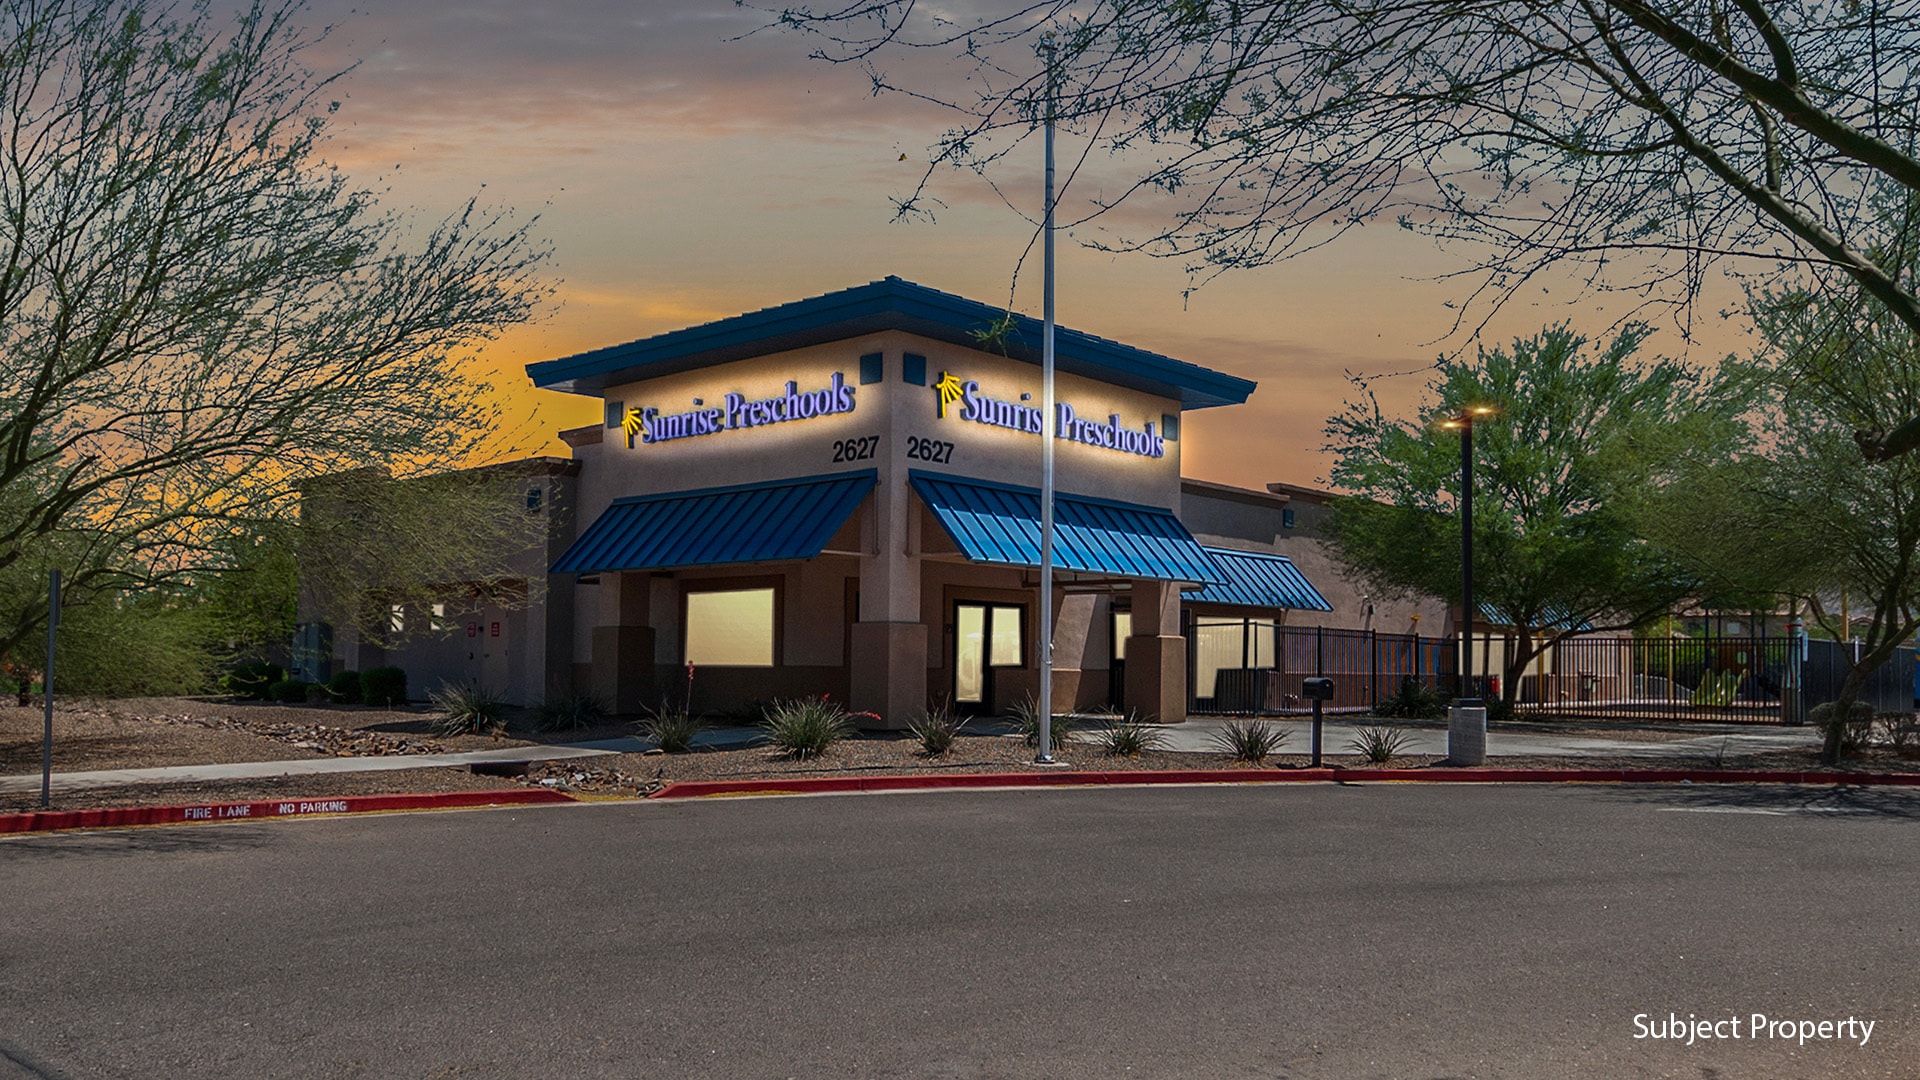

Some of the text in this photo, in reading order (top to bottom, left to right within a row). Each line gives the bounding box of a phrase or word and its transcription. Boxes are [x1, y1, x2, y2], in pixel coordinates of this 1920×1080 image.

[642, 371, 855, 443] Sunrise Preschools
[960, 380, 1164, 458] Sunris Preschools
[833, 436, 880, 463] 2627
[907, 436, 955, 464] 2627
[184, 805, 251, 819] FIRE LANE
[279, 801, 347, 814] NO PARKING
